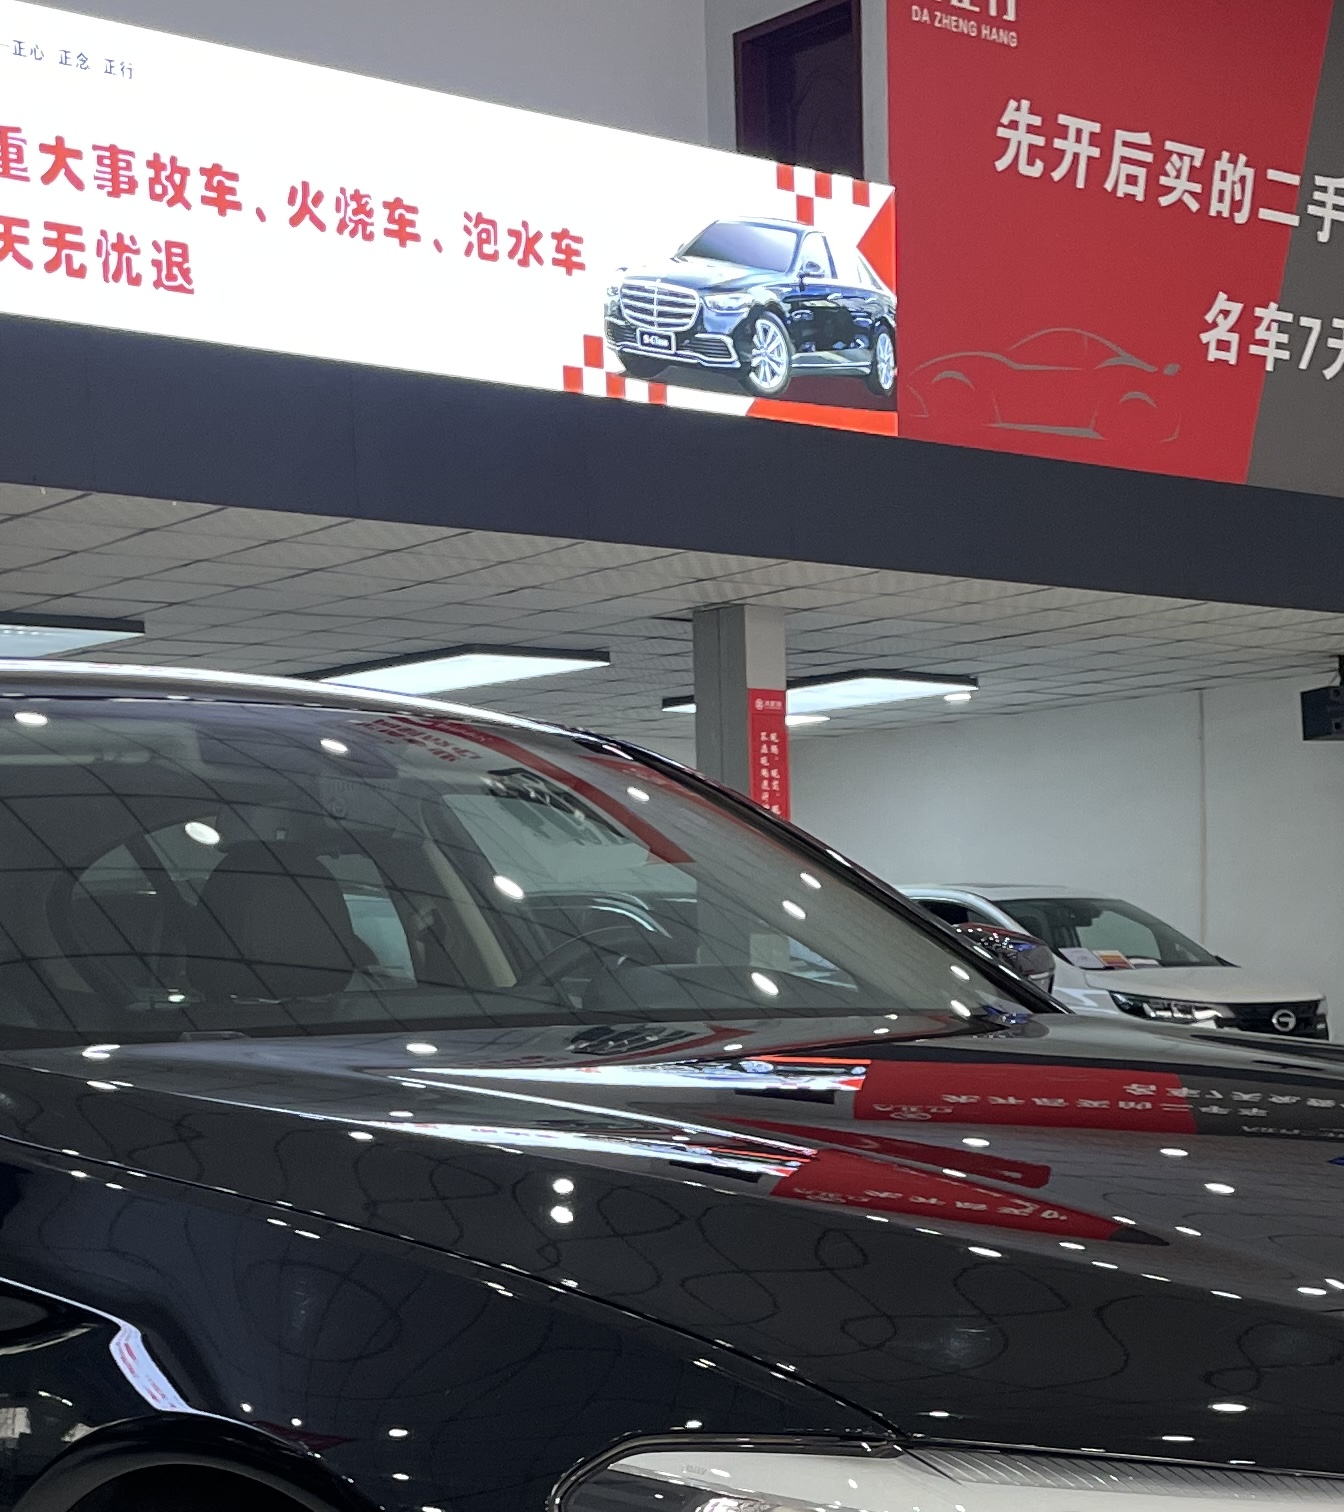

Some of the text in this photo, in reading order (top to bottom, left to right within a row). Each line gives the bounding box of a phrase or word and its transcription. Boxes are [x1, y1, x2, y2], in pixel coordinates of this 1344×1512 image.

[911, 5, 931, 25] DA
[934, 11, 978, 37] ZHENG
[981, 24, 1018, 48] HANG
